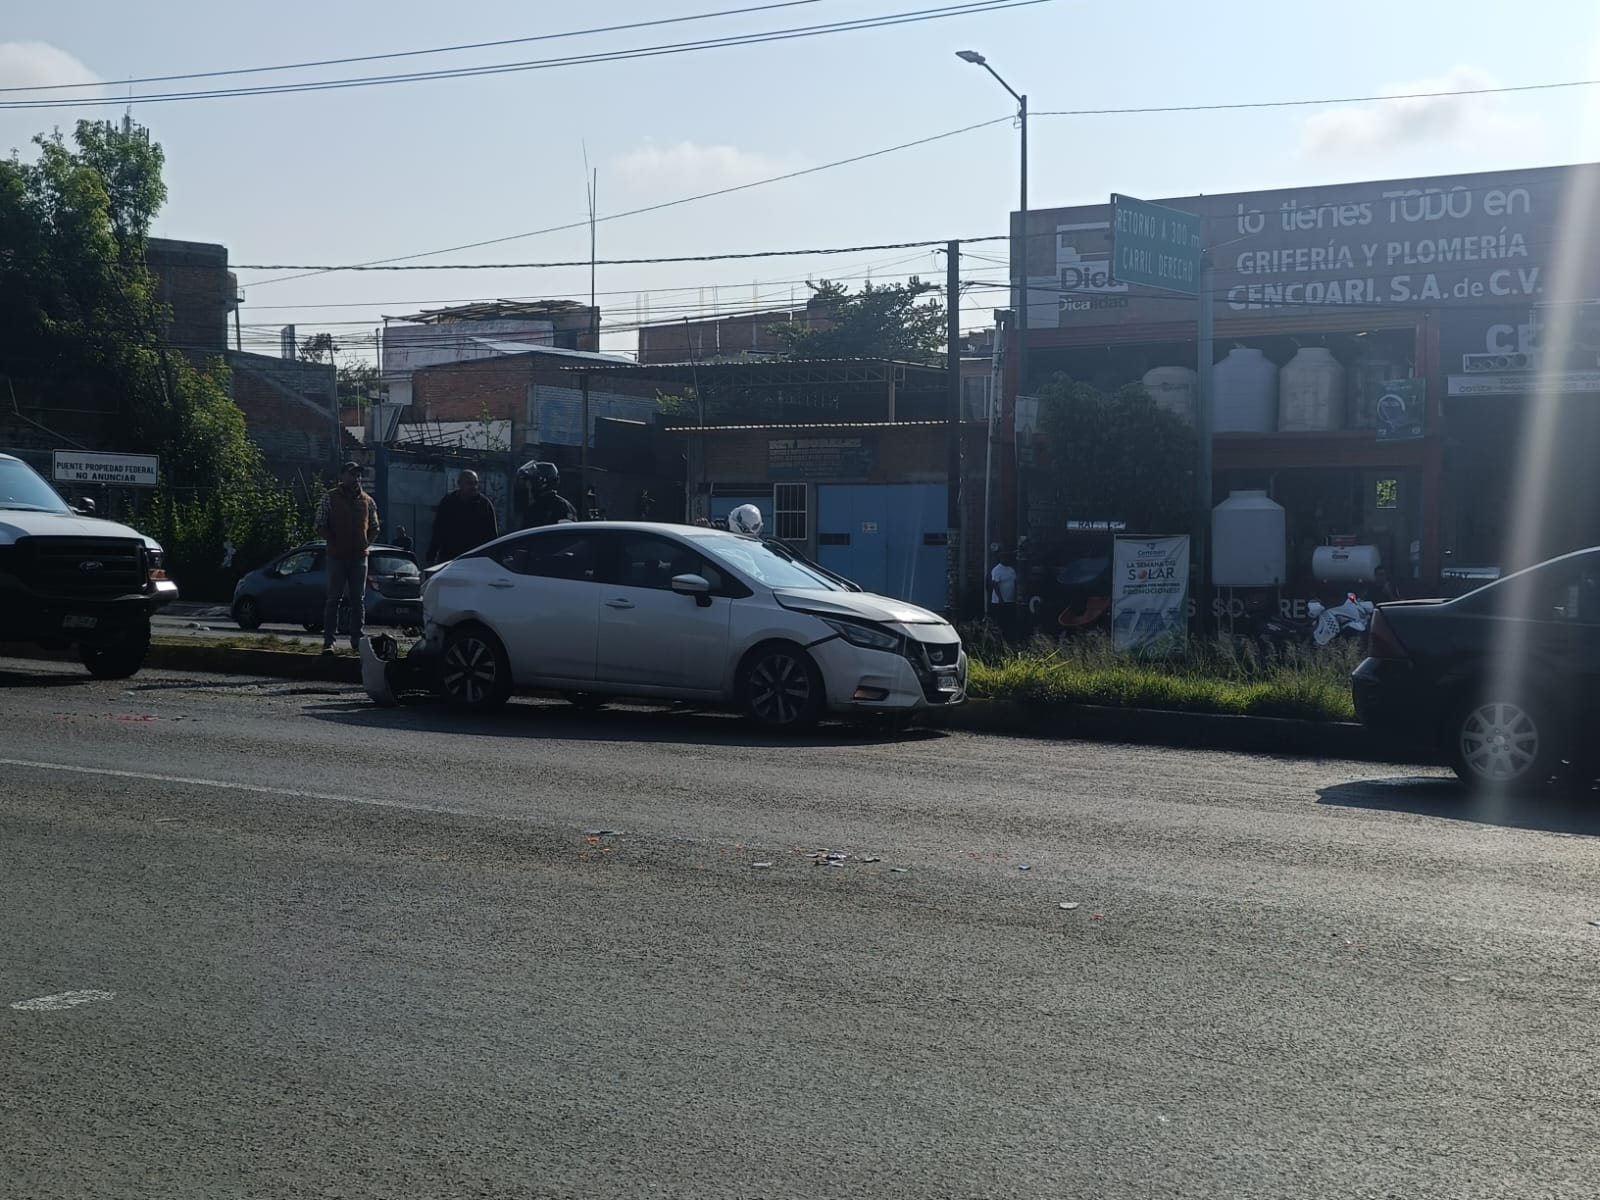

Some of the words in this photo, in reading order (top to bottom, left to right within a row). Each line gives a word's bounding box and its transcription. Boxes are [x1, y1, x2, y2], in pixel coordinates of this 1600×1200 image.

[1117, 208, 1156, 240] RETORNO
[1161, 219, 1167, 240] A
[1171, 221, 1188, 246] 300
[1237, 203, 1265, 234] lo
[1280, 199, 1373, 231] tienes
[1382, 186, 1472, 223] TODO
[1484, 188, 1530, 216] en
[1122, 247, 1153, 275] CARRIL
[1158, 254, 1193, 282] DERECHO
[1237, 239, 1354, 274] GRIFERÍA
[1361, 243, 1378, 267] Y
[1387, 226, 1528, 265] PLOMERÍA
[1390, 274, 1449, 302] S.A.
[1453, 278, 1484, 298] de
[1489, 267, 1544, 296] C.V.
[56, 461, 83, 471] PUENTE
[85, 463, 123, 473] PROPIEDAD
[125, 465, 154, 474] FEDERAL
[75, 471, 88, 480] NO
[92, 472, 136, 482] ANUNCIAR
